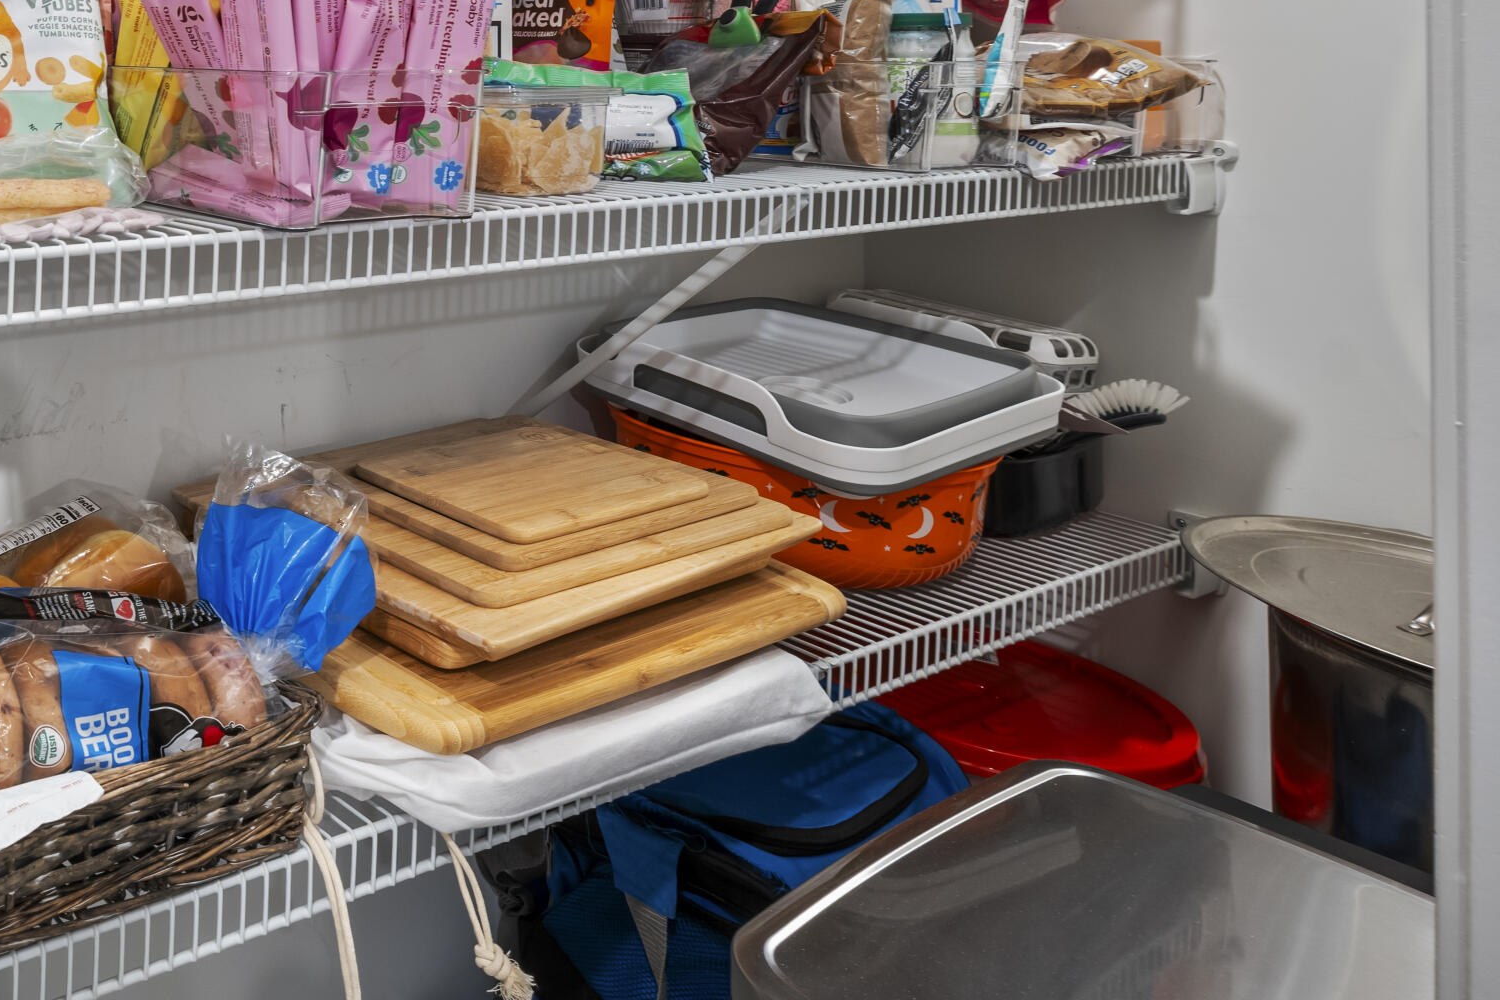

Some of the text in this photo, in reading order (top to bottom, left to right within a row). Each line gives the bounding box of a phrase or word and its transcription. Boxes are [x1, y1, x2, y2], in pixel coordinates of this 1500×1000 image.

[28, 23, 94, 32] VEGGIE SNACKS
[71, 15, 94, 23] CORN
[512, 8, 564, 28] aked
[39, 30, 83, 39] TUMBLING
[185, 26, 201, 53] baby
[435, 18, 457, 75] teething
[429, 73, 445, 114] wafers
[75, 495, 98, 513] Facts
[52, 511, 70, 526] 160
[135, 608, 147, 621] THE
[105, 707, 136, 765] BOO
[38, 730, 48, 764] ORGANIC
[48, 734, 57, 759] USDA
